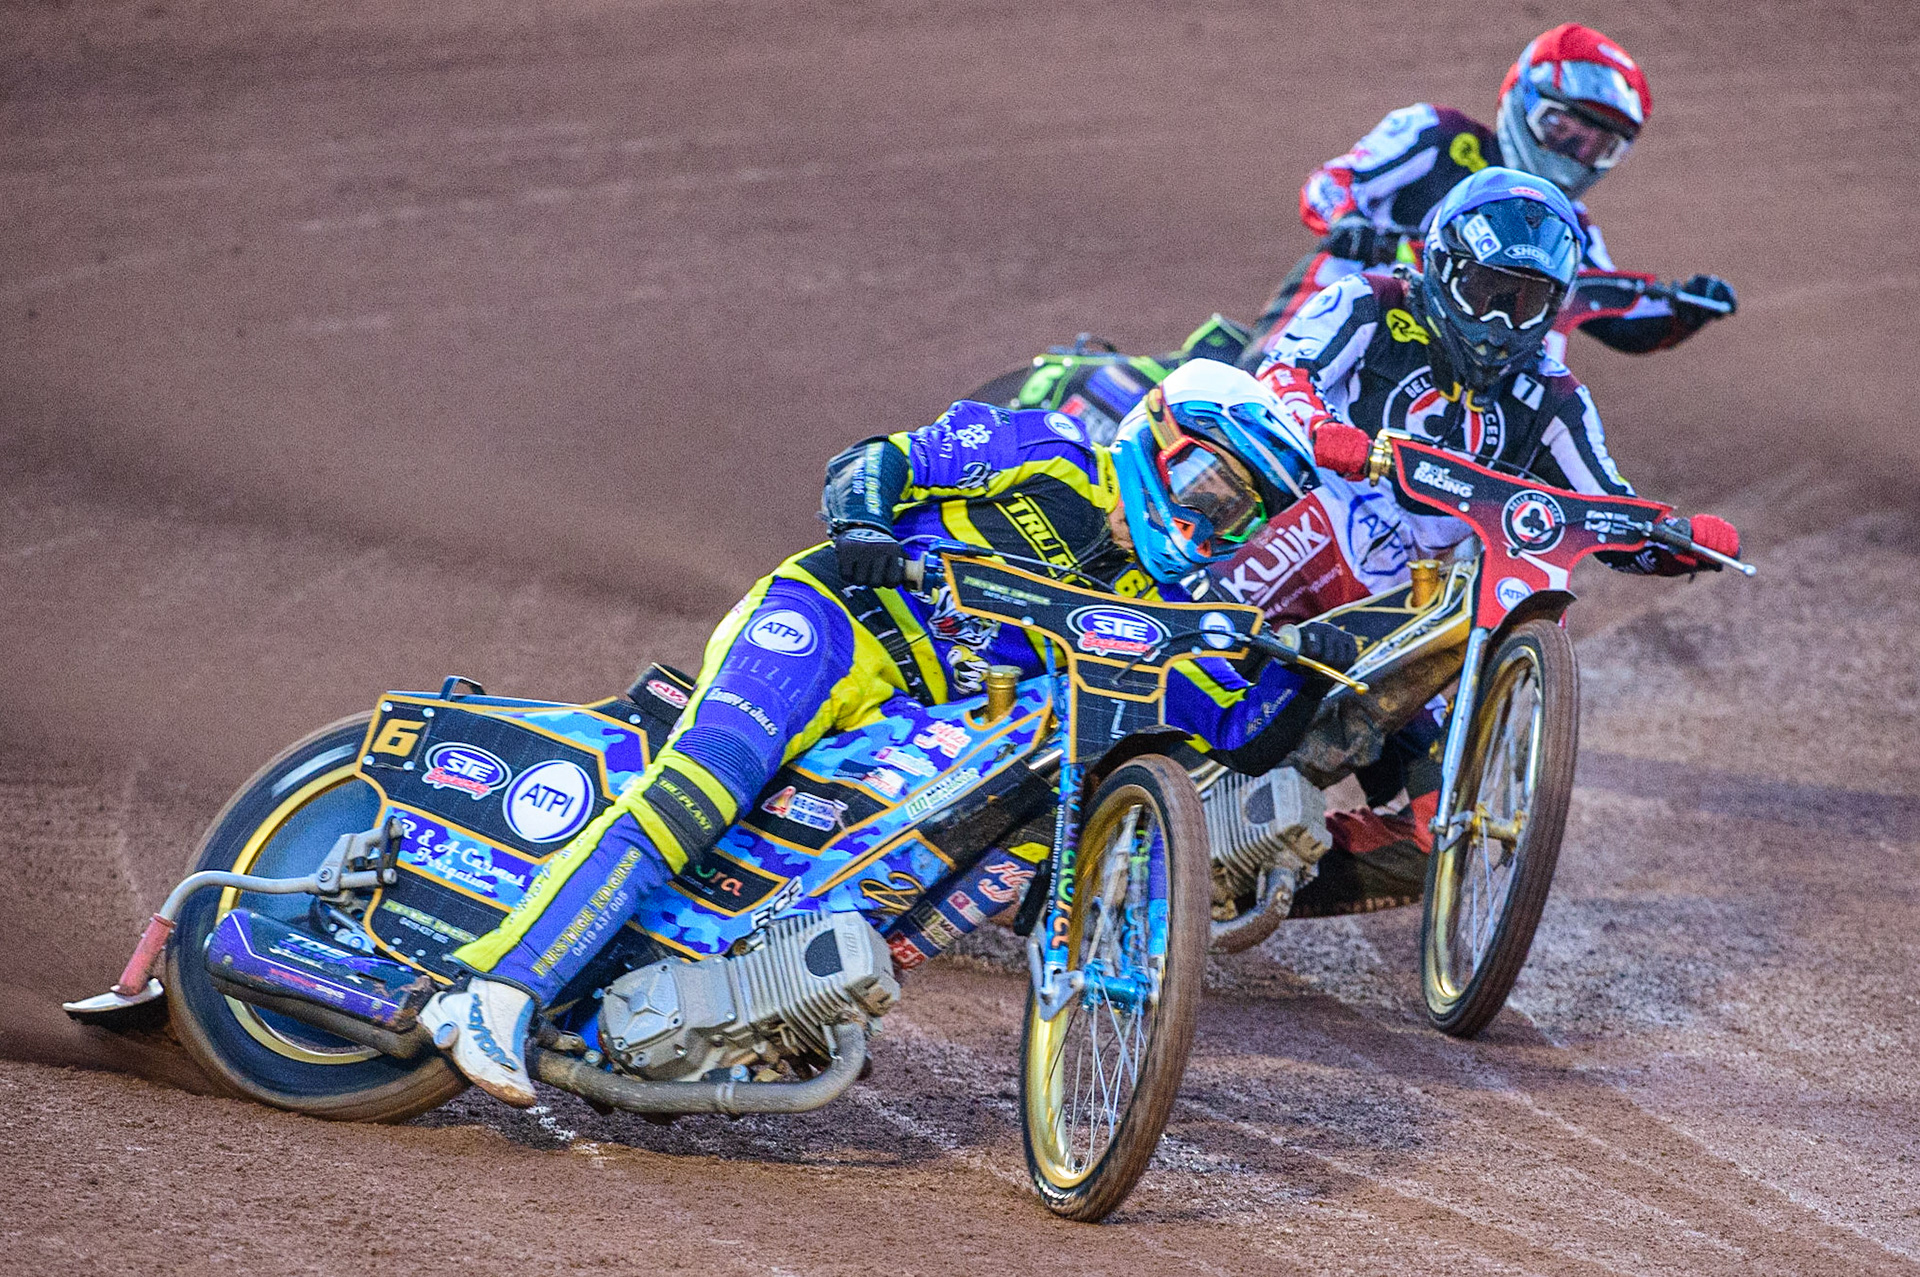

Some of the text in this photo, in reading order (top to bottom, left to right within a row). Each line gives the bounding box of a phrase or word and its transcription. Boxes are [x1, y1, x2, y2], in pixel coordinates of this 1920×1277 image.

[1404, 374, 1433, 399] BEL
[1484, 411, 1499, 446] CES
[1413, 469, 1474, 498] RACING
[757, 621, 805, 645] ATPI
[1092, 613, 1149, 642] STE
[371, 718, 426, 757] 6
[442, 751, 495, 782] STE
[518, 783, 576, 818] ATPI
[402, 818, 418, 840] R
[417, 829, 436, 848] &
[414, 846, 496, 893] Irrigation
[531, 904, 598, 978] PRESTIGE
[588, 845, 643, 912] EDGING
